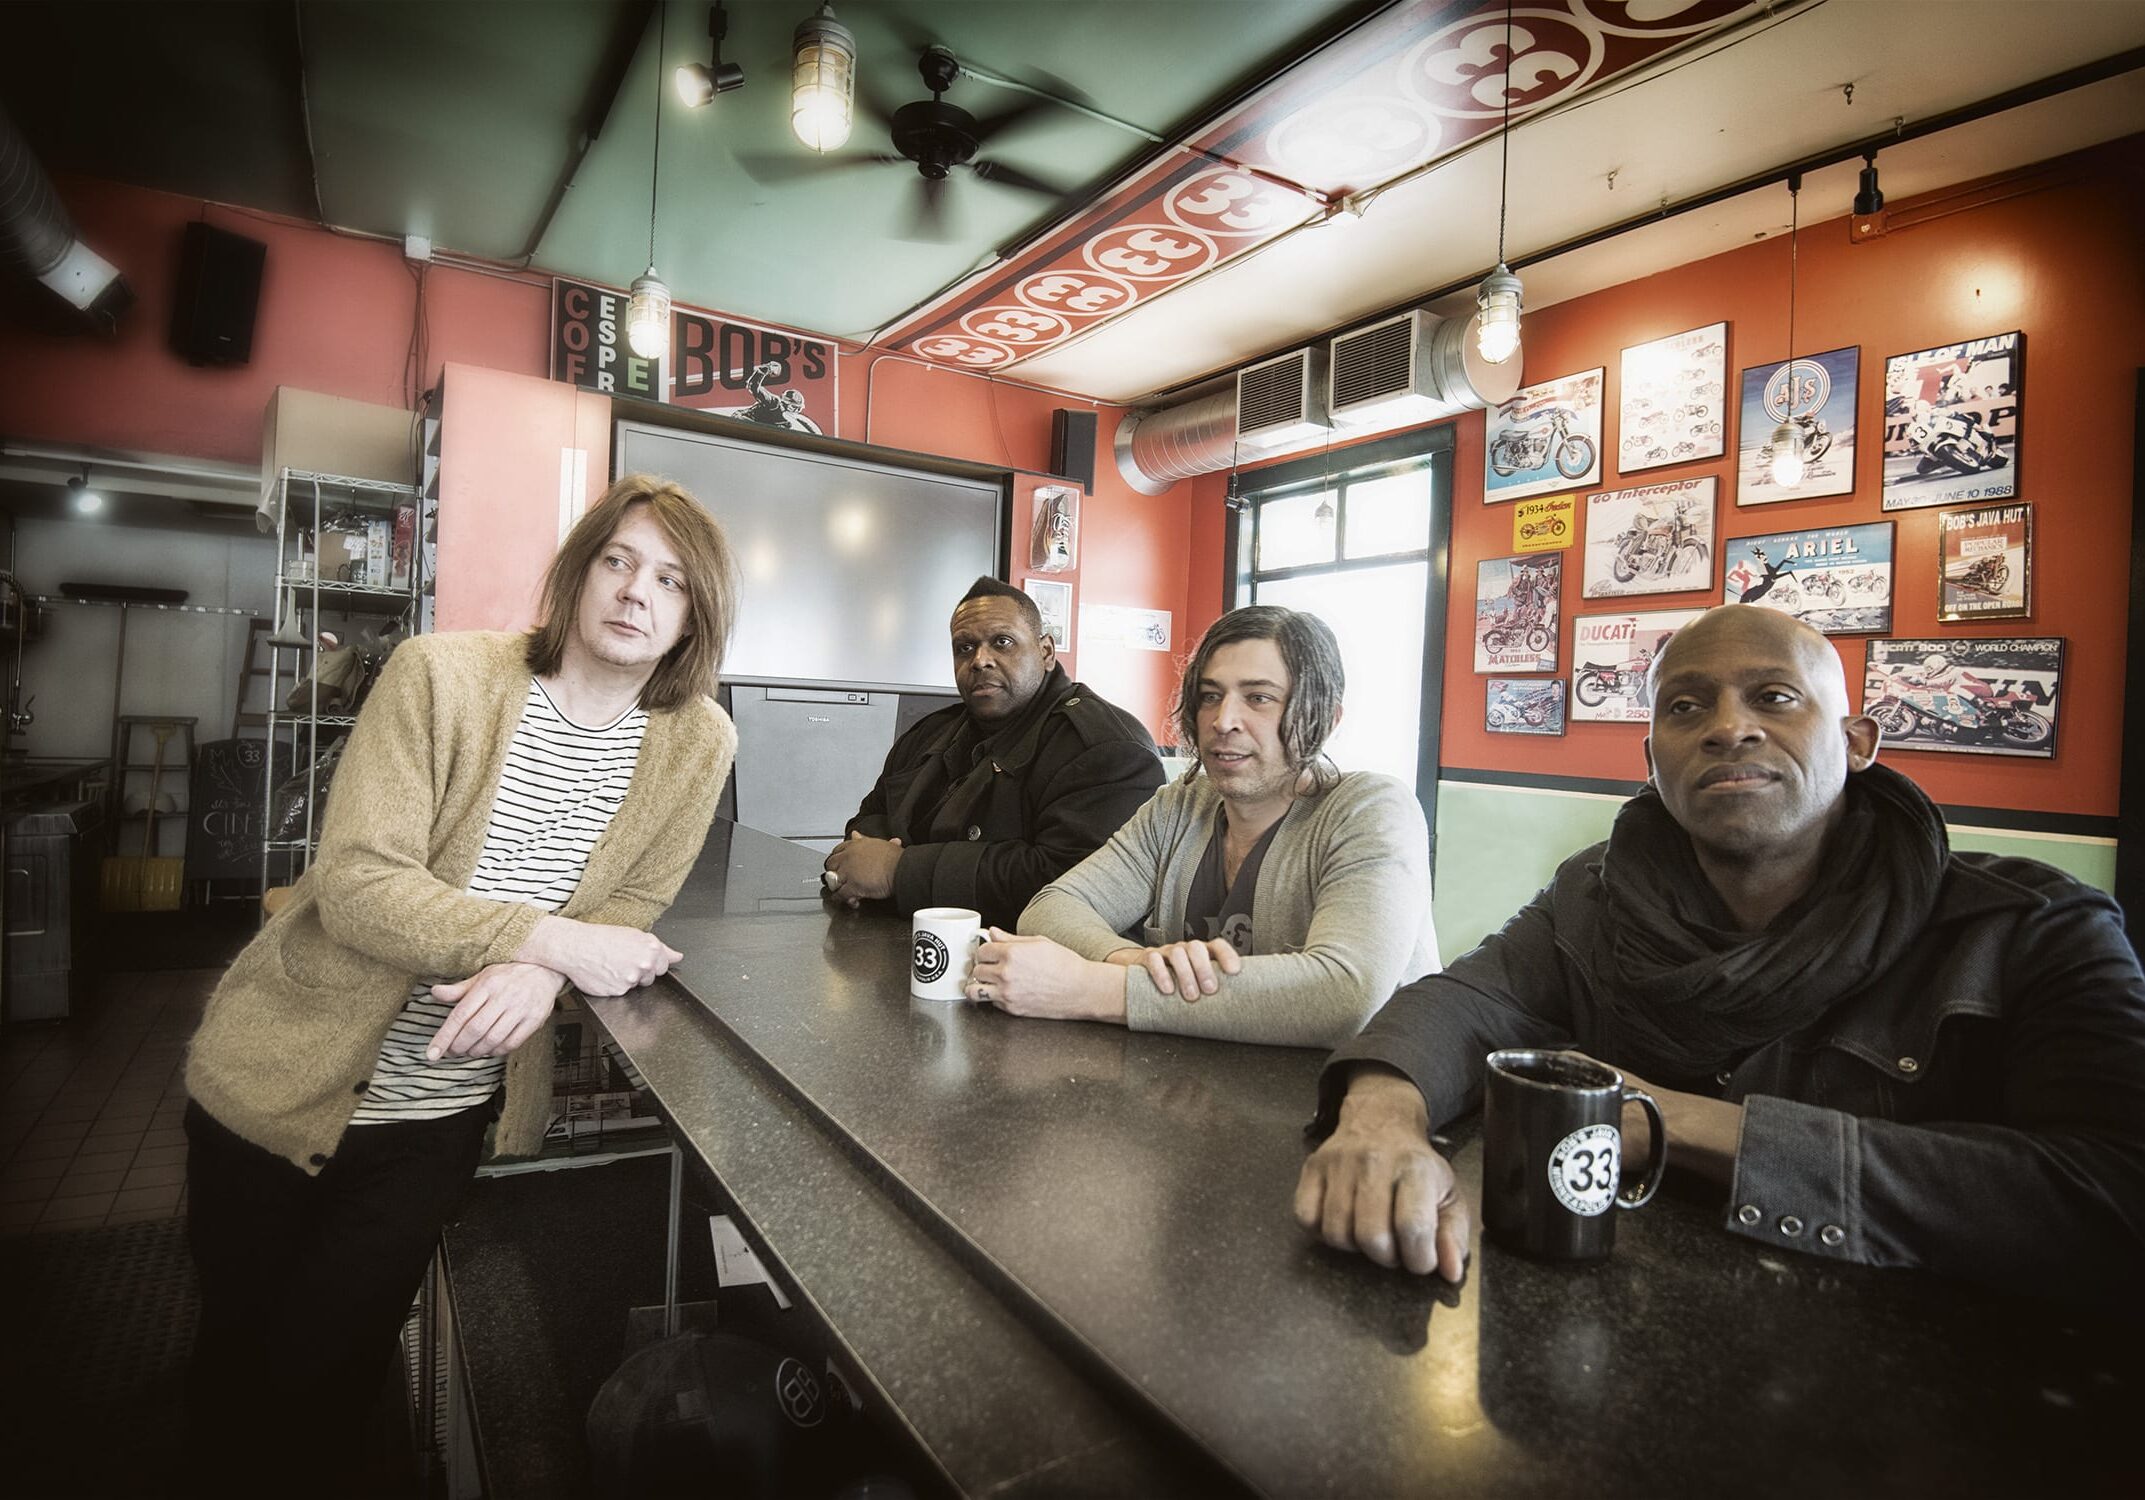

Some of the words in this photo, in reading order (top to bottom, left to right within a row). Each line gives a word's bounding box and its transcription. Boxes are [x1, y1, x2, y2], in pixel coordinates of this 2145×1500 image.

[1099, 229, 1203, 276] 33
[1026, 275, 1125, 313] 33
[977, 309, 1058, 342] 33
[676, 311, 827, 397] BOB'S
[927, 337, 1003, 363] 33
[1965, 335, 2016, 357] MAN
[1934, 490, 1965, 503] JUNE
[1967, 489, 1980, 498] 10
[1984, 485, 2012, 497] 1988
[1526, 504, 1544, 515] 1934
[1946, 513, 1975, 531] BOB'S
[1976, 510, 2000, 527] JAVA
[2002, 508, 2023, 523] HUT
[1786, 537, 1860, 560] ARIEL
[1974, 643, 2007, 652] WORLD
[244, 750, 261, 763] 33
[915, 945, 938, 968] 33
[1570, 1147, 1613, 1192] 33
